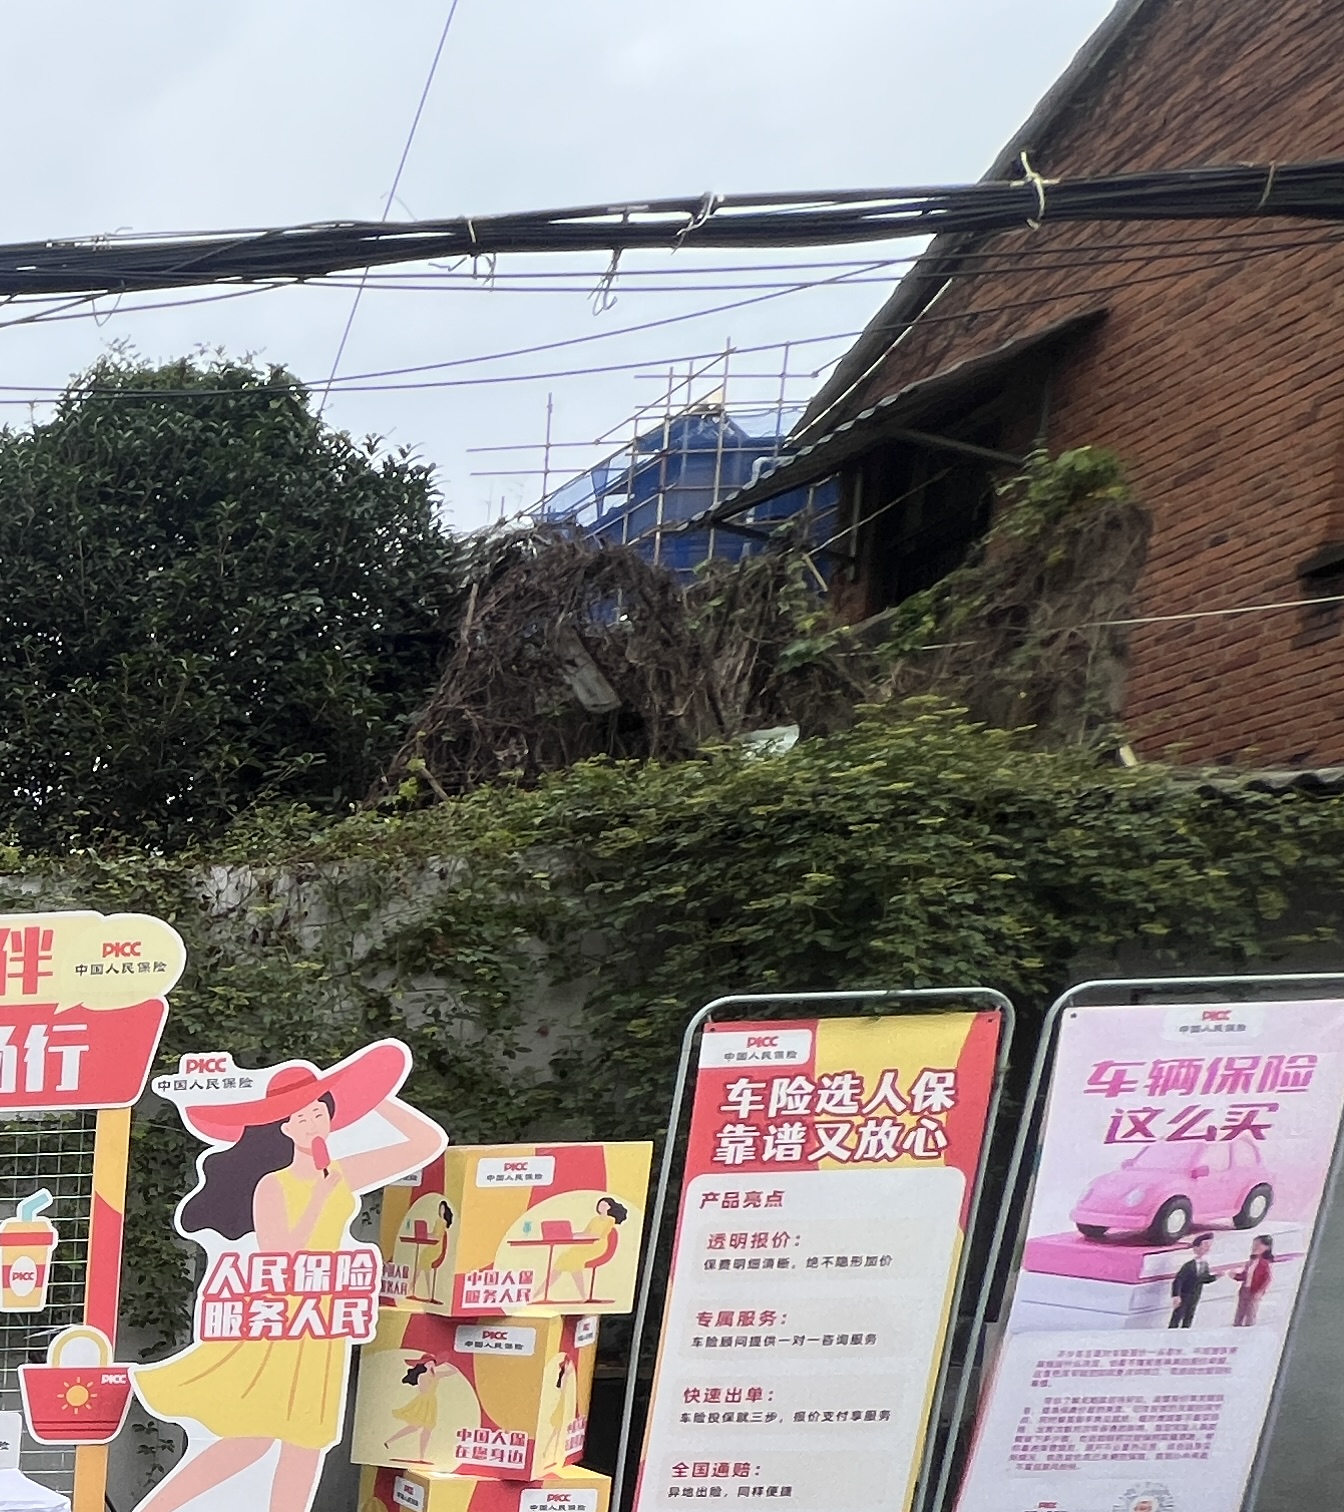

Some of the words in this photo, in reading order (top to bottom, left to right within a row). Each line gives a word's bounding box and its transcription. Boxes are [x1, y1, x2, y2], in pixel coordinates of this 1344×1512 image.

[102, 941, 141, 958] PICC
[75, 960, 167, 977] 中国人民保险
[747, 1036, 779, 1048] PICC
[186, 1058, 226, 1073] PICC
[157, 1077, 253, 1091] 中国人民保险
[1083, 1054, 1318, 1098] 车辆保险
[720, 1070, 956, 1118] 车险选人保
[1104, 1103, 1279, 1144] 这么买
[712, 1118, 948, 1164] 靠谱又放心
[699, 1190, 785, 1209] 产品亮点
[12, 1271, 34, 1281] PICC
[206, 1252, 376, 1296] 人民保险
[467, 1270, 534, 1286] 中国人保
[202, 1297, 371, 1339] 服务人民
[482, 1330, 508, 1341] PICC
[100, 1375, 127, 1384] PICC
[457, 1428, 526, 1447] 中国人保
[455, 1446, 524, 1464] 在您身边
